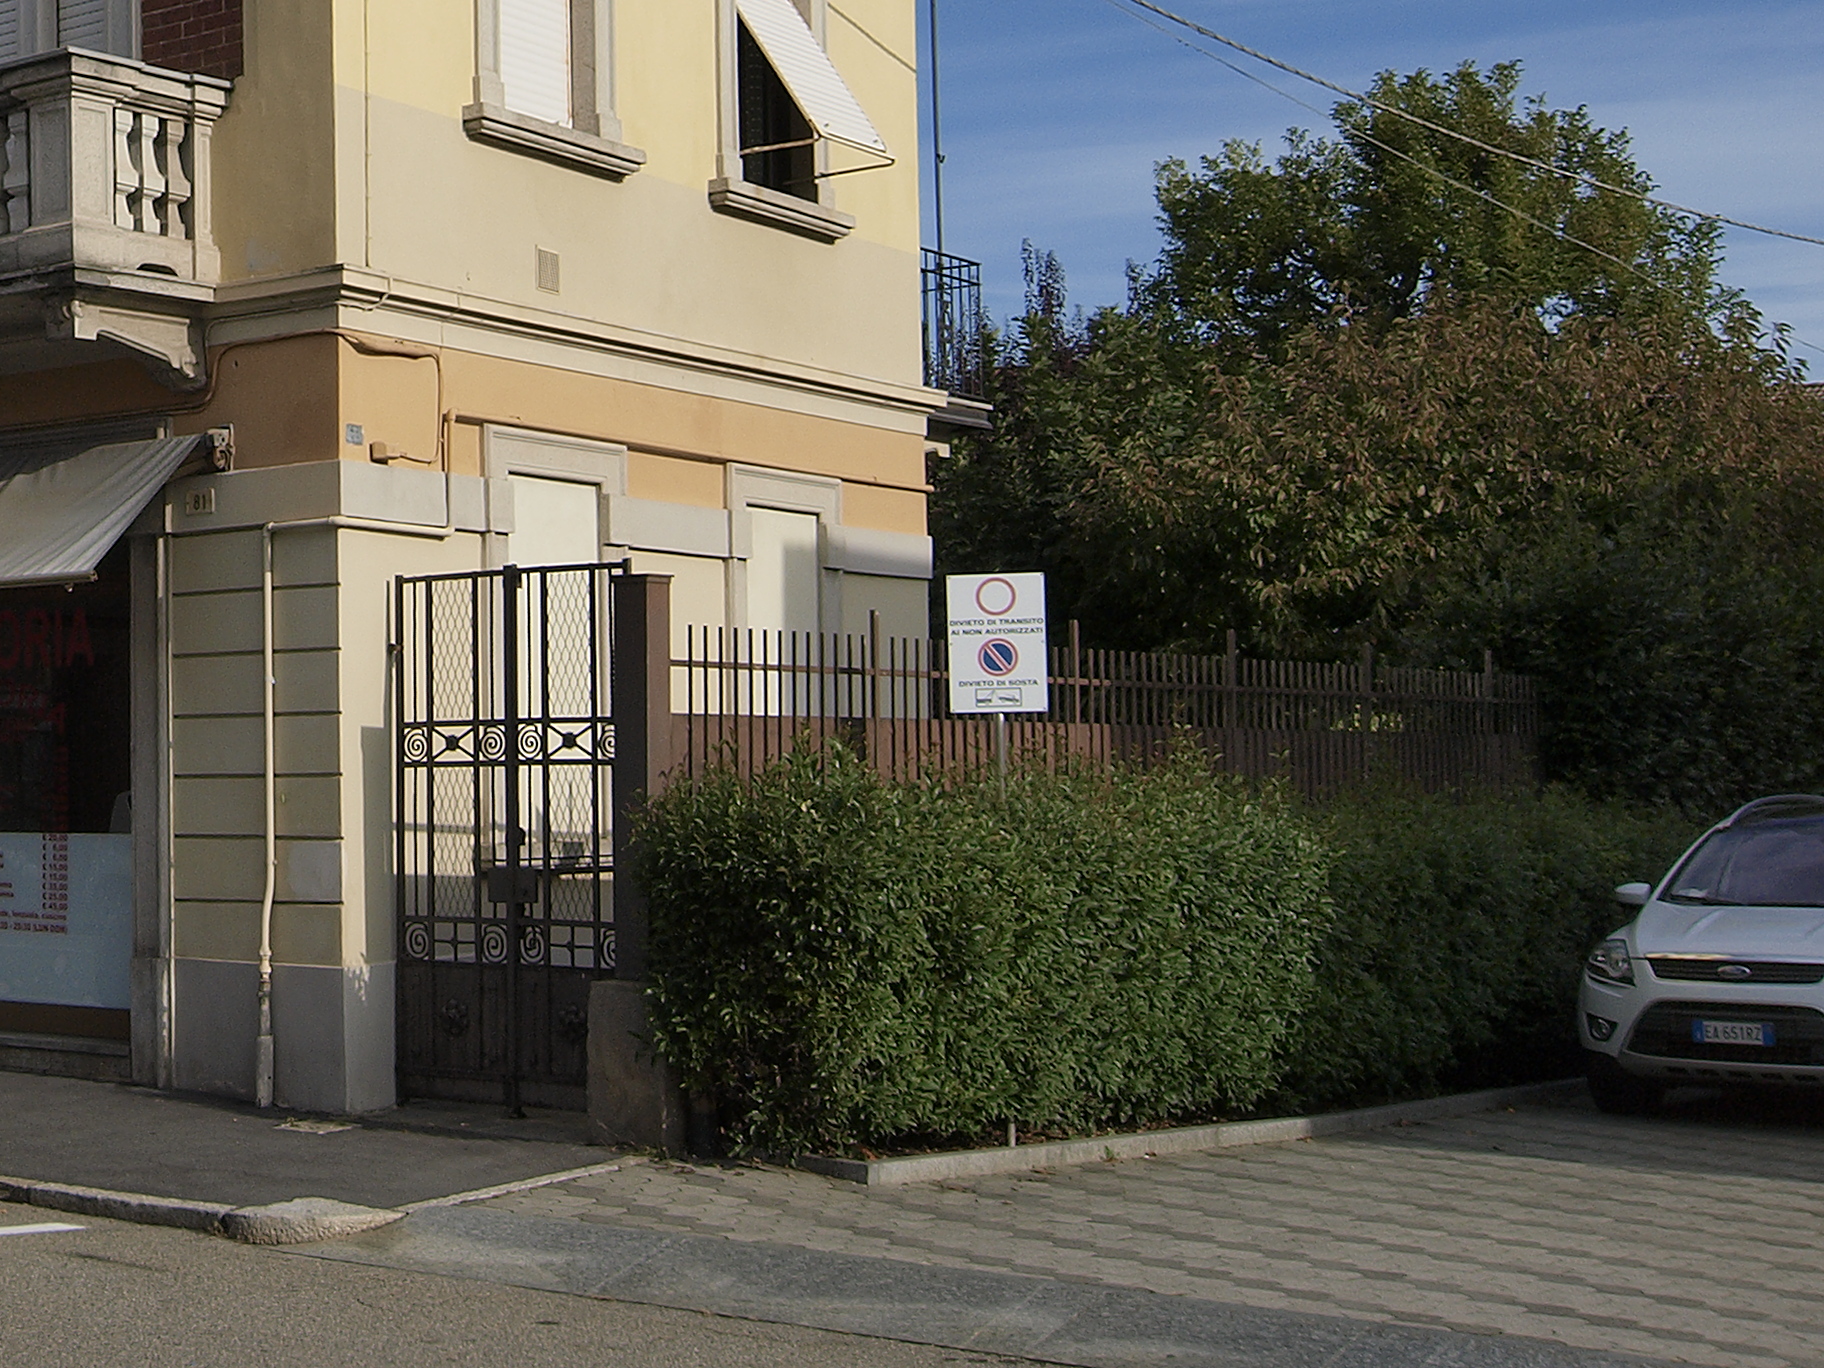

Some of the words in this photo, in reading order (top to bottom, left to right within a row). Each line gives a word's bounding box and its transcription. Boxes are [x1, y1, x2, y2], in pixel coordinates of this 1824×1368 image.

[193, 494, 206, 511] 81
[1705, 1025, 1720, 1039] EA
[1722, 1026, 1762, 1041] 651RZ
